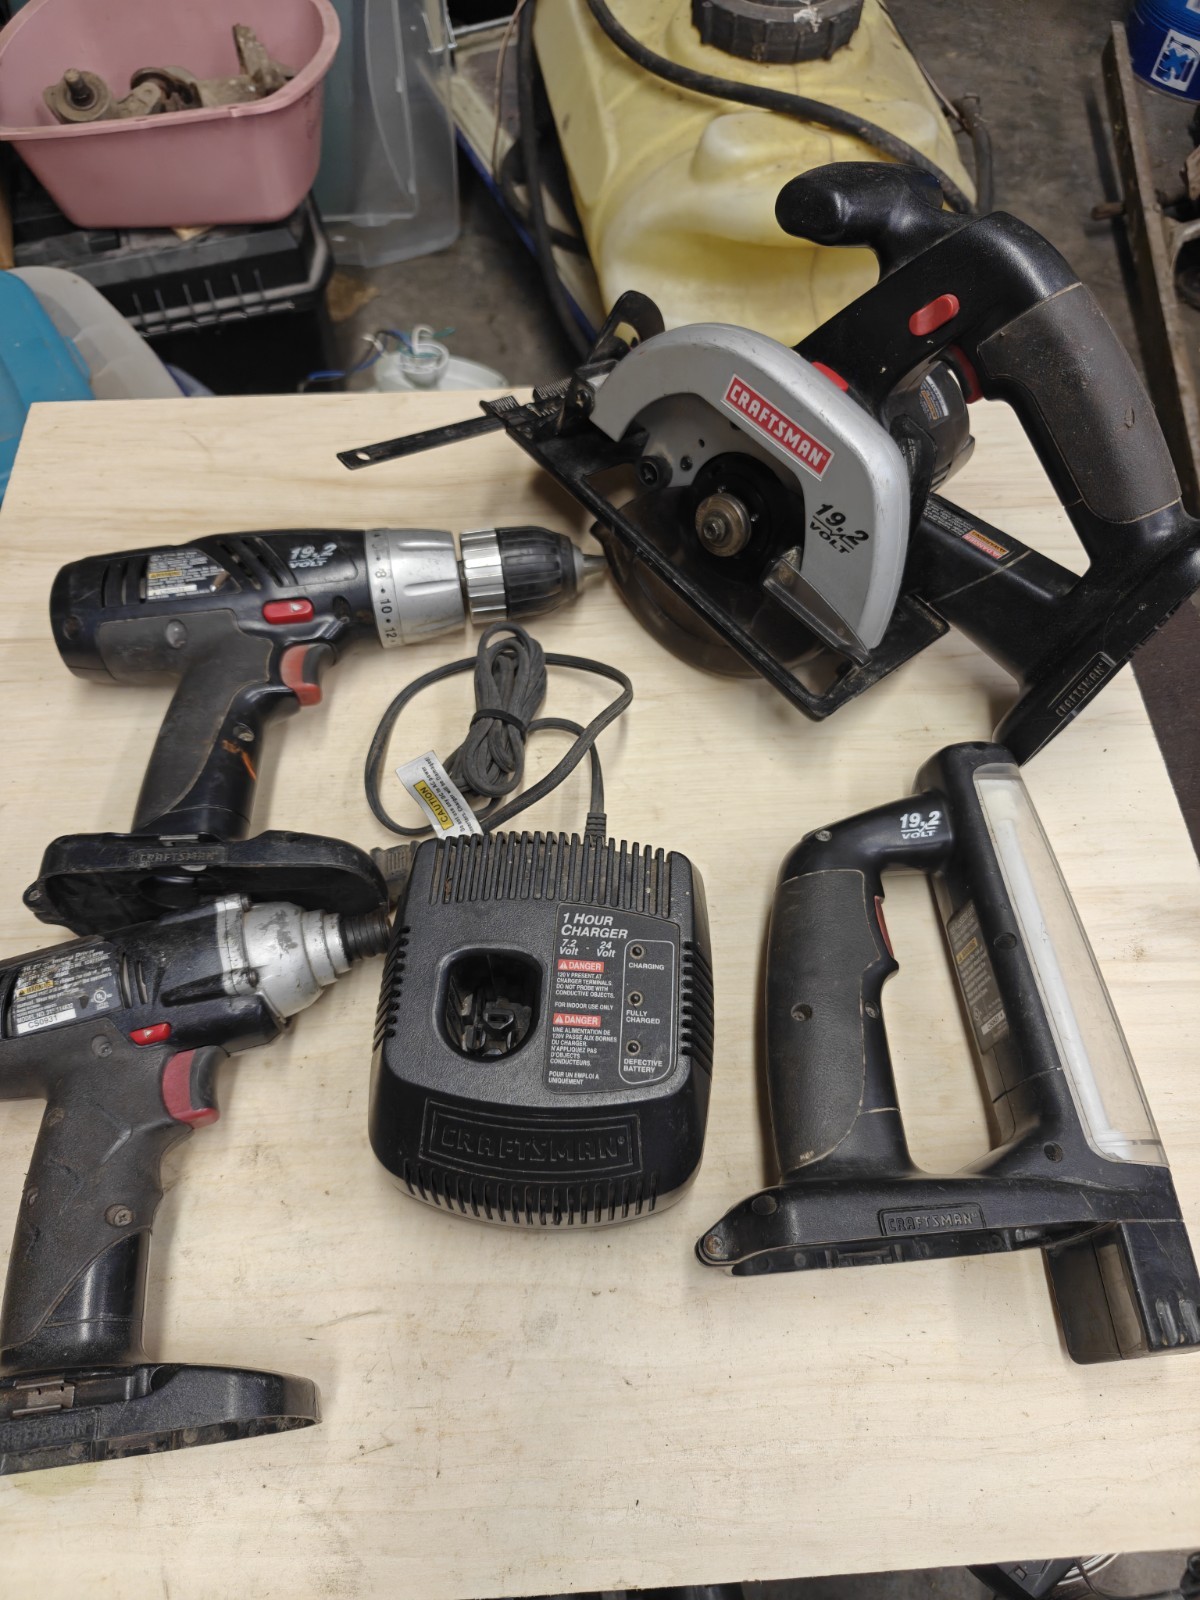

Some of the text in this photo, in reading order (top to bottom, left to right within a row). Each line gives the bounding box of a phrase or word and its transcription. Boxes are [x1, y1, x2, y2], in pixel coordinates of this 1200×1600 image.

[730, 385, 823, 466] CRAFTSMAN
[815, 503, 869, 546] 19.2
[809, 522, 850, 554] VOLT
[290, 542, 337, 559] 19.2
[288, 560, 328, 568] VOLT
[380, 598, 393, 614] 10
[385, 627, 397, 639] 12
[1056, 665, 1105, 716] CRAFTSMAN
[420, 786, 448, 822] CAUTION
[900, 810, 941, 829] 19.2
[902, 830, 936, 839] VOLT
[563, 912, 613, 926] 1 HOUR
[561, 924, 628, 939] CHARGER
[562, 939, 612, 949] 7.2 24
[560, 946, 579, 956] Volt
[597, 949, 616, 958] Volt
[569, 962, 601, 971] DANGER
[628, 962, 664, 970] CHARGING
[565, 1015, 598, 1025] DANGER
[626, 1016, 660, 1024] CHARGED
[624, 1058, 662, 1067] DEFECTIVE
[441, 1124, 618, 1162] CRAFTSMAN
[888, 1214, 972, 1232] CRAFTSMAN
